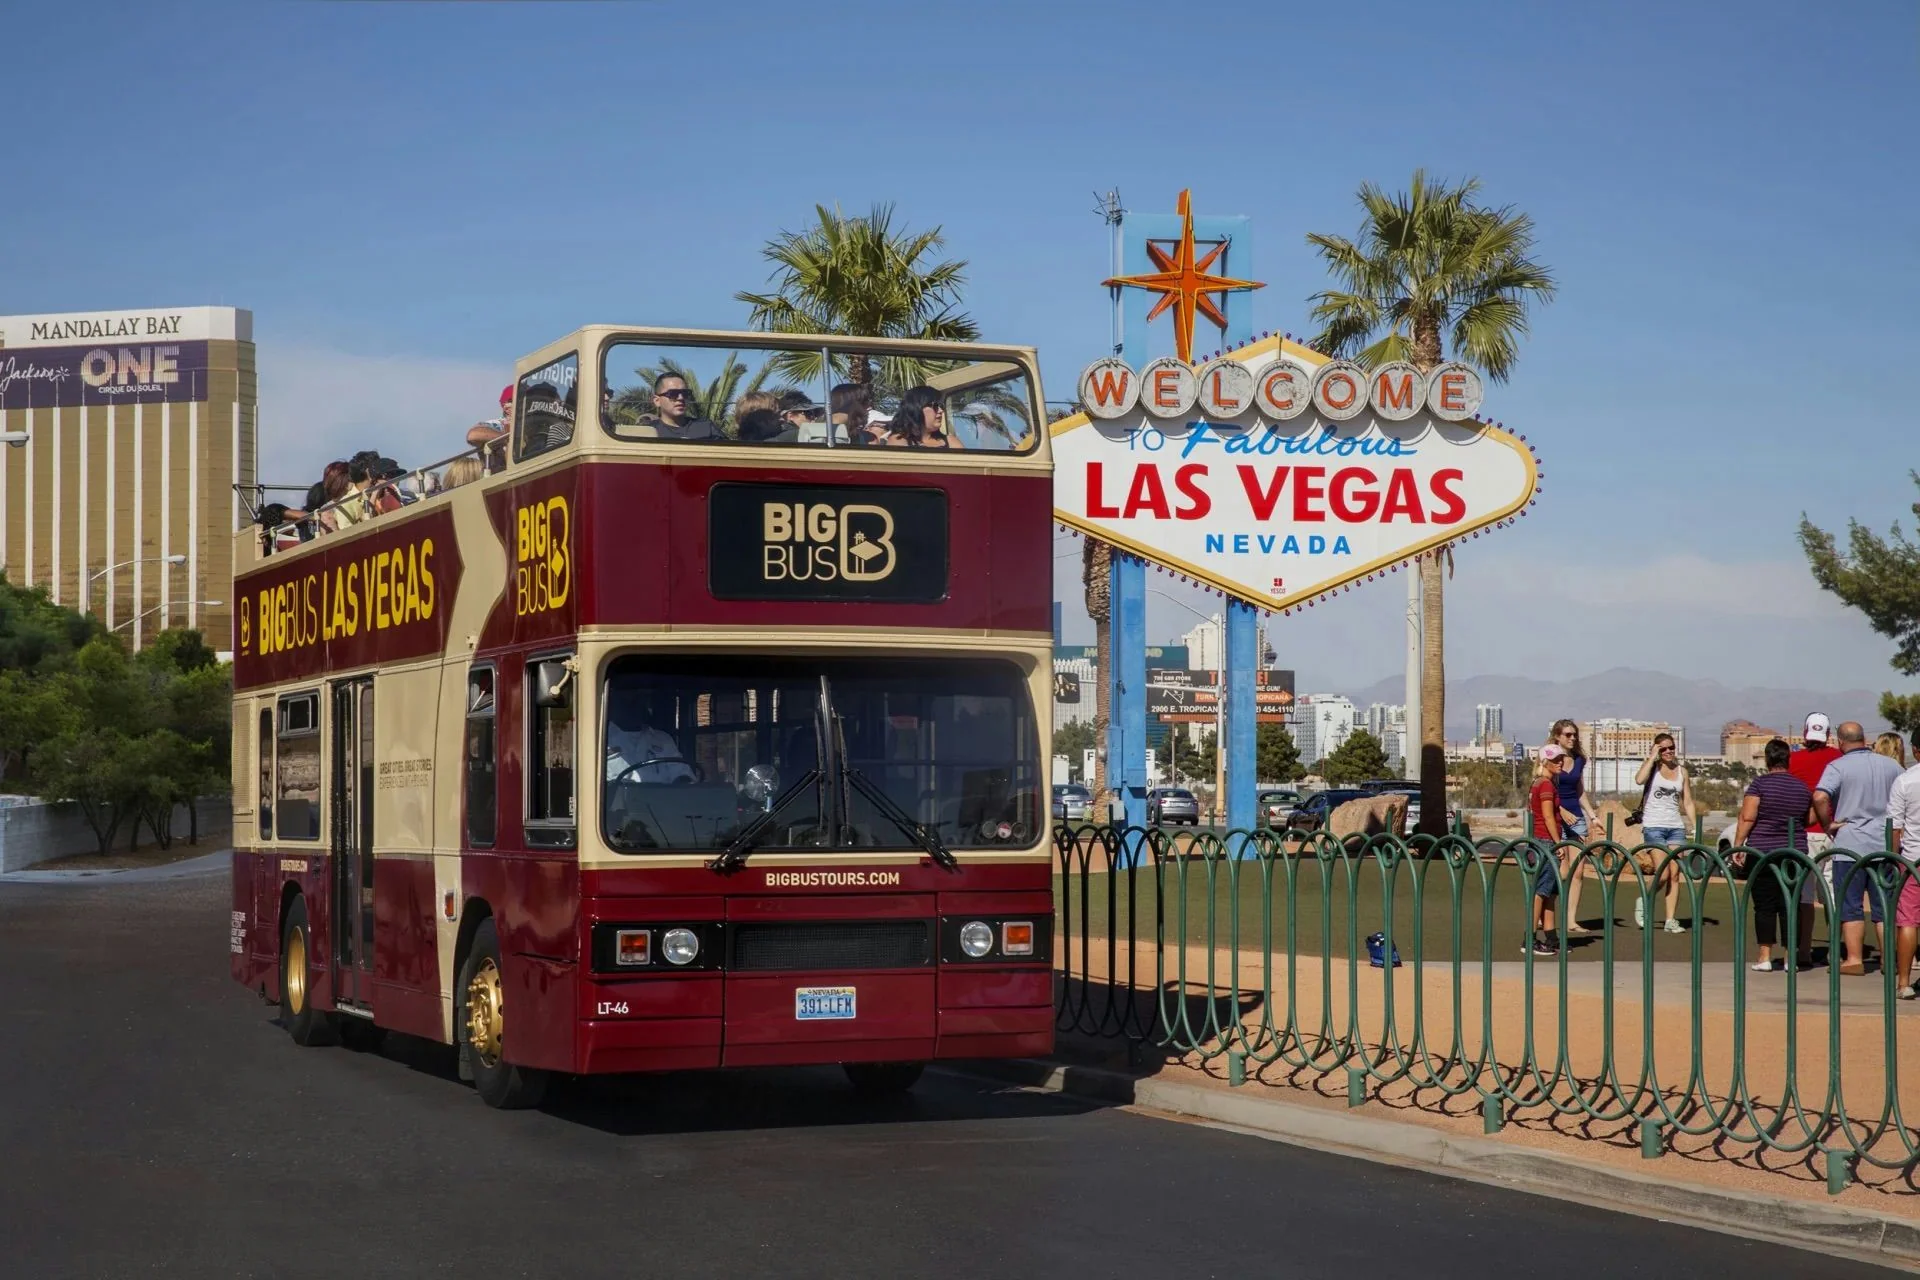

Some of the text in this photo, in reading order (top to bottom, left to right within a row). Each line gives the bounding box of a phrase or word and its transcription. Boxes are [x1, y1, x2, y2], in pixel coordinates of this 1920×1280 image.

[30, 316, 182, 340] MANDALAY BAY
[80, 345, 180, 387] ONE
[98, 386, 125, 394] CIRQUE
[138, 384, 162, 392] SOLEIL
[1089, 370, 1467, 410] WELCOME
[1123, 421, 1418, 459] TO Fabulous
[1085, 462, 1467, 525] LAS VEGAS
[517, 502, 547, 562] BIG
[763, 502, 837, 543] BIG
[763, 545, 837, 581] BUS
[1206, 534, 1352, 556] NEVADA
[322, 562, 359, 642] LAS
[363, 538, 435, 632] VEGAS
[517, 562, 547, 616] BUS
[1151, 705, 1169, 713] 2900
[1170, 705, 1178, 713] E.
[1179, 705, 1219, 713] TROPICAN
[1262, 705, 1294, 713] 454-1110
[765, 872, 900, 886] BIGBUSTOURS.COM
[597, 1001, 629, 1015] LT-46
